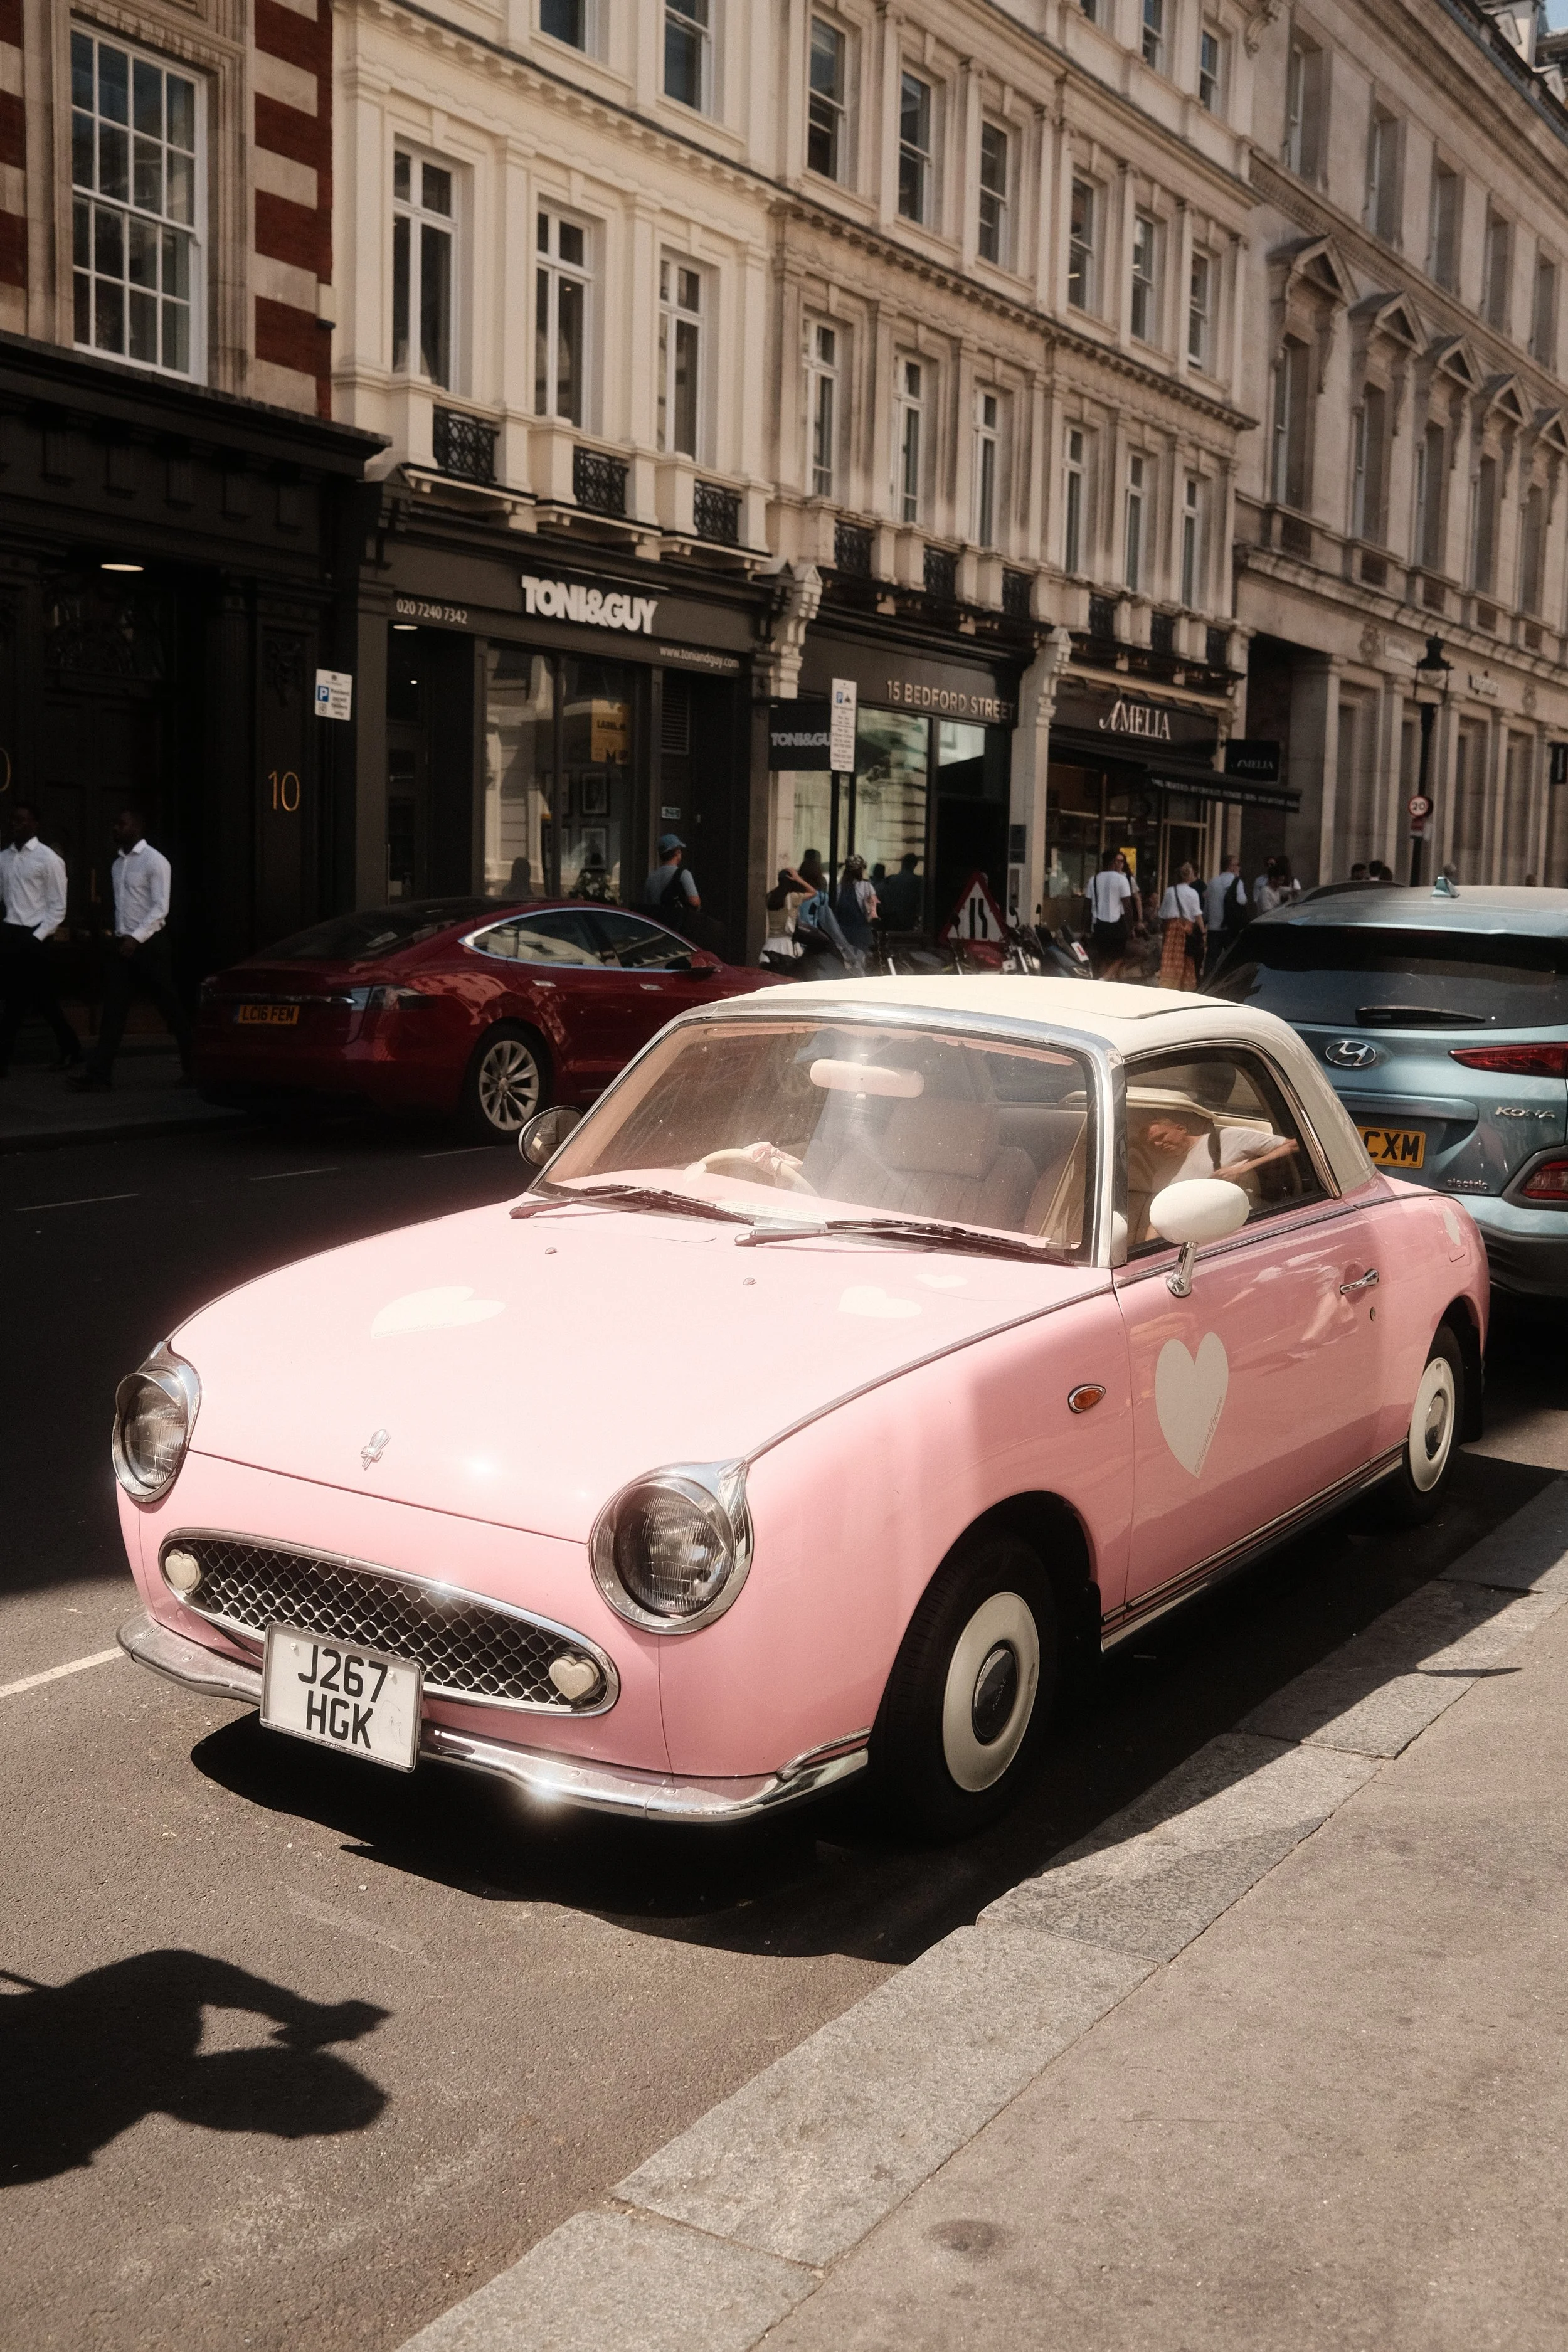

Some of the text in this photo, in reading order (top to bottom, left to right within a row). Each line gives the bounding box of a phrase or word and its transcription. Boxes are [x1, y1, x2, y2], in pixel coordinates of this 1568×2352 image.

[396, 598, 467, 625] 020 7240 7342
[521, 575, 658, 634] TONI&GUY
[659, 646, 739, 669] www.toniandguy.com
[887, 680, 1015, 720] 15 BEDFORD STREET
[1099, 699, 1171, 740] AMELIA
[770, 732, 831, 746] TONI&GU
[268, 770, 300, 812] 10
[1412, 802, 1426, 811] 20
[242, 1005, 295, 1022] LC16 FEM
[1495, 1106, 1555, 1118] KONA
[1364, 1131, 1420, 1162] CXM
[1447, 1177, 1488, 1189] electric
[297, 1644, 388, 1703] J267
[305, 1690, 374, 1749] HGK
